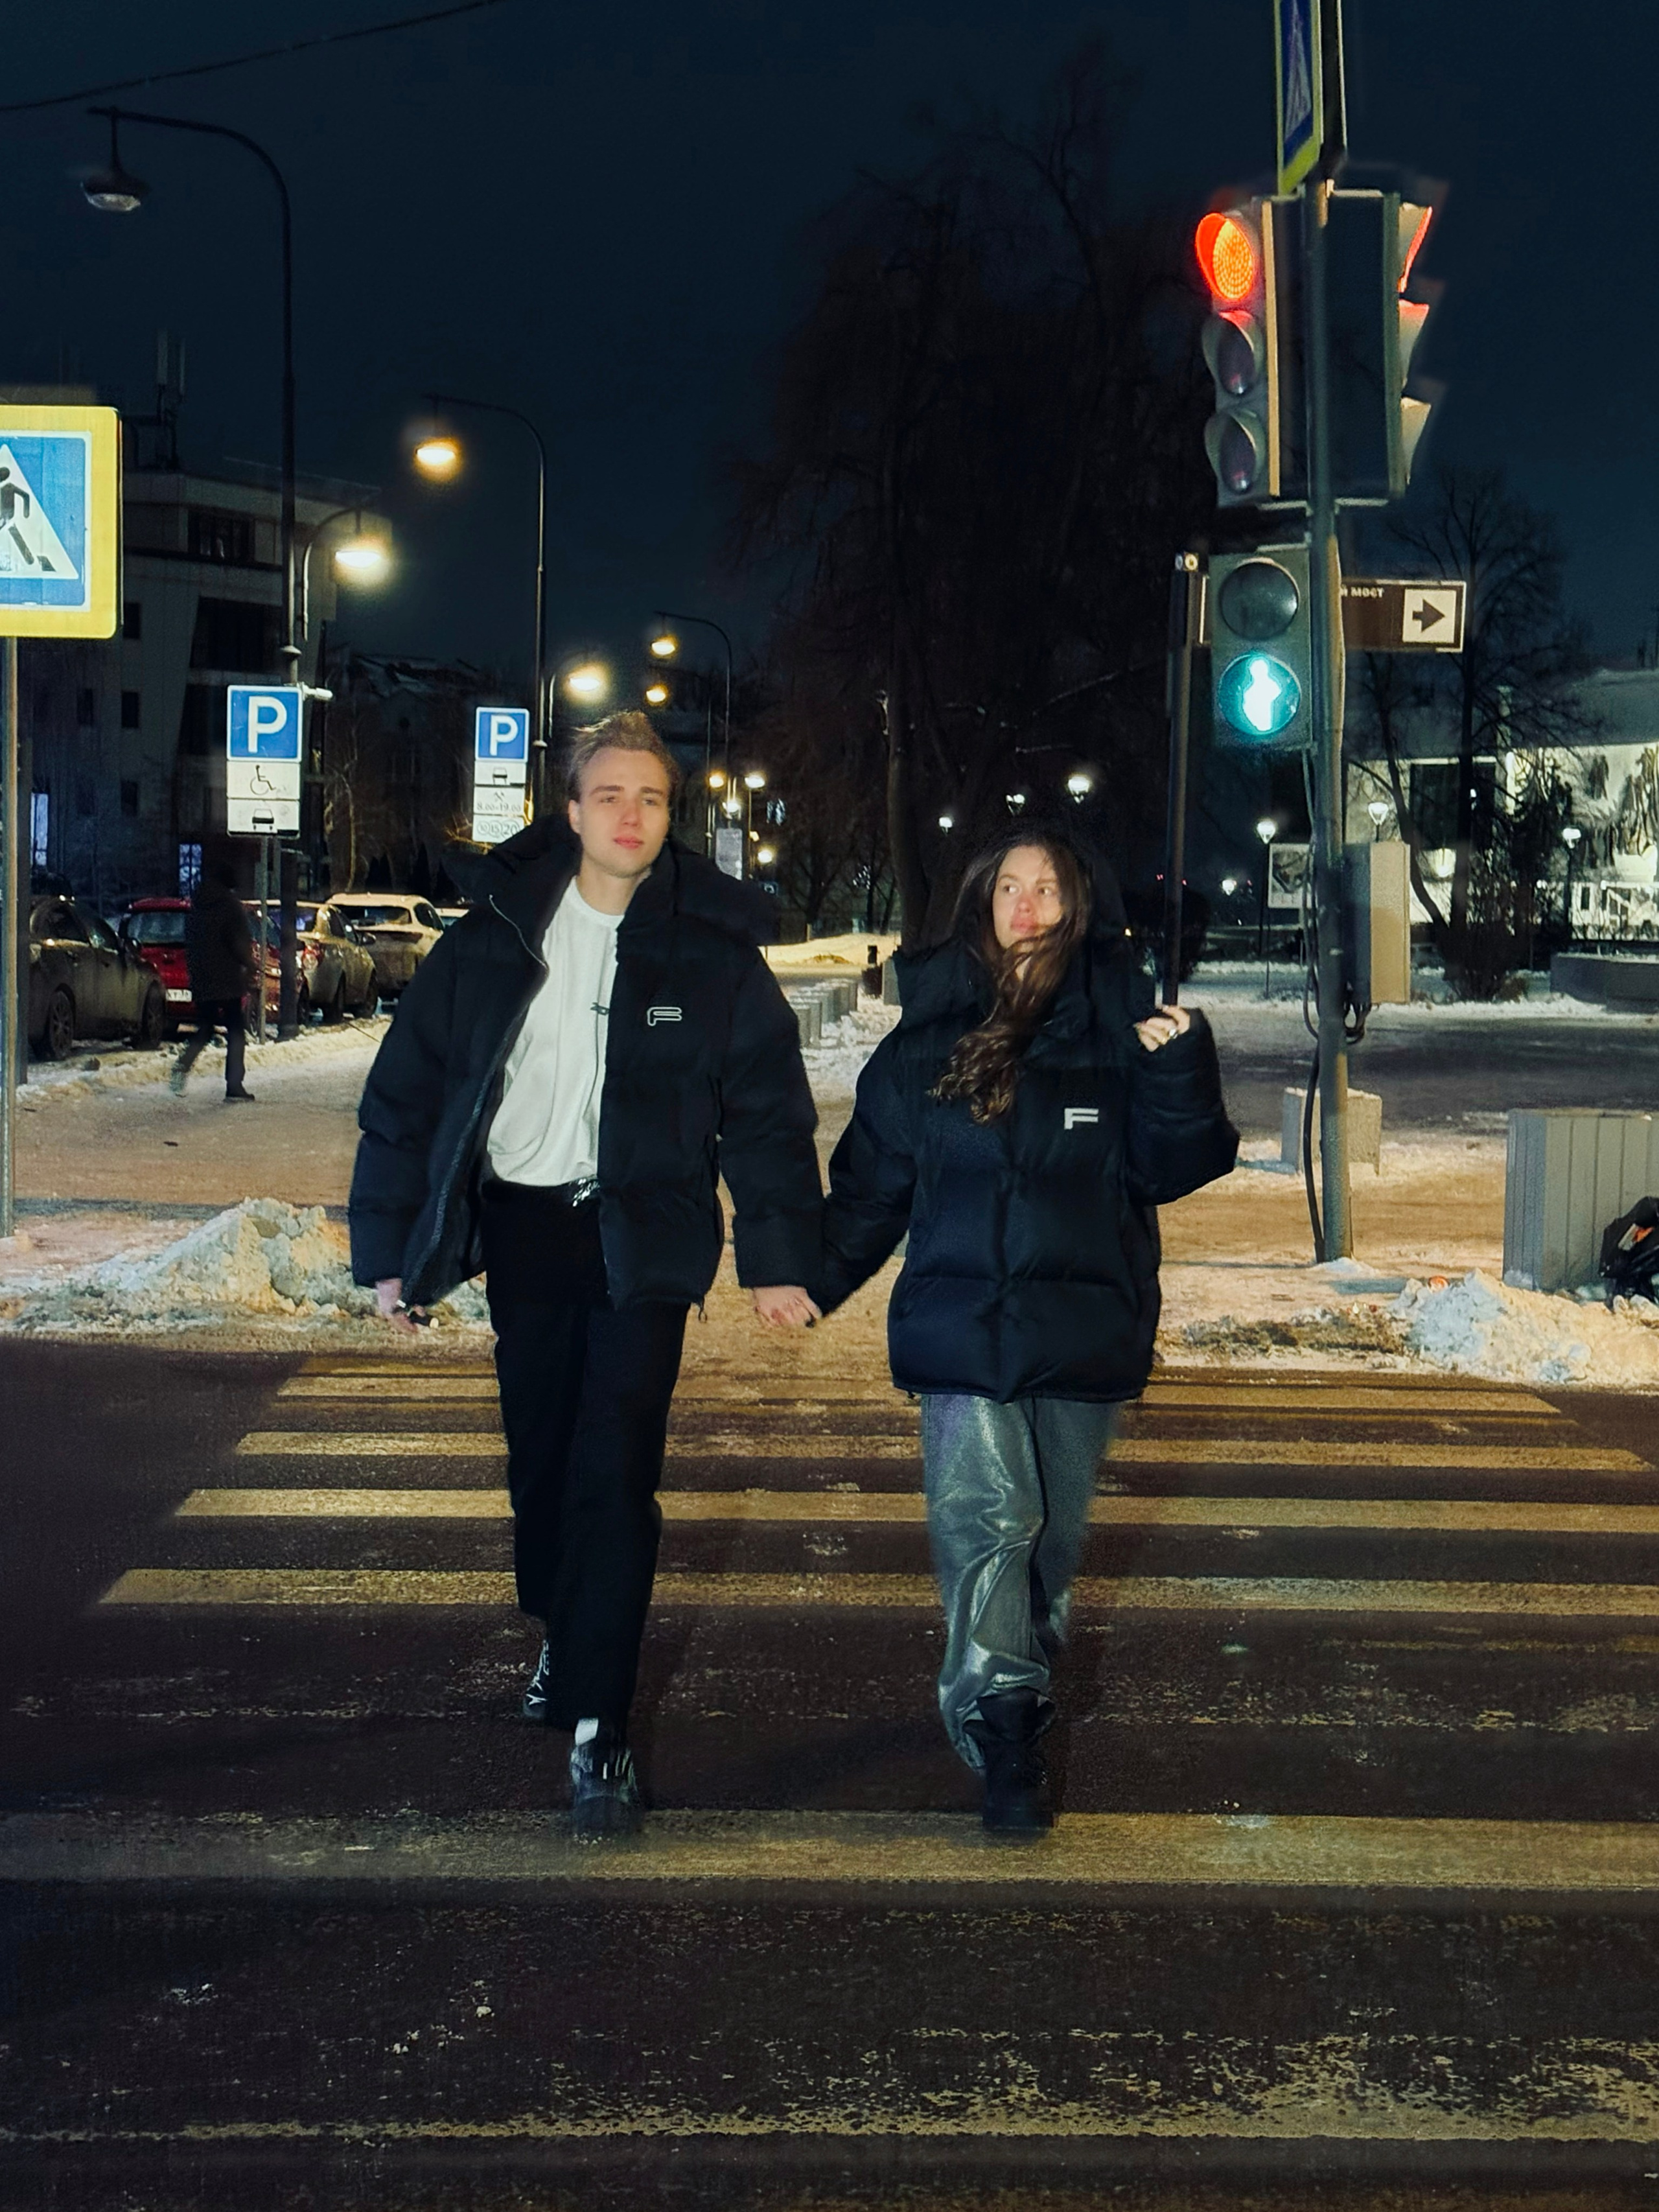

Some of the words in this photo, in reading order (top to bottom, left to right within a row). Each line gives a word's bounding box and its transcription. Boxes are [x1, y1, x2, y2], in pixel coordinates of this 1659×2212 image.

[248, 695, 287, 753] P
[490, 714, 518, 756] P
[1064, 1108, 1098, 1130] F
